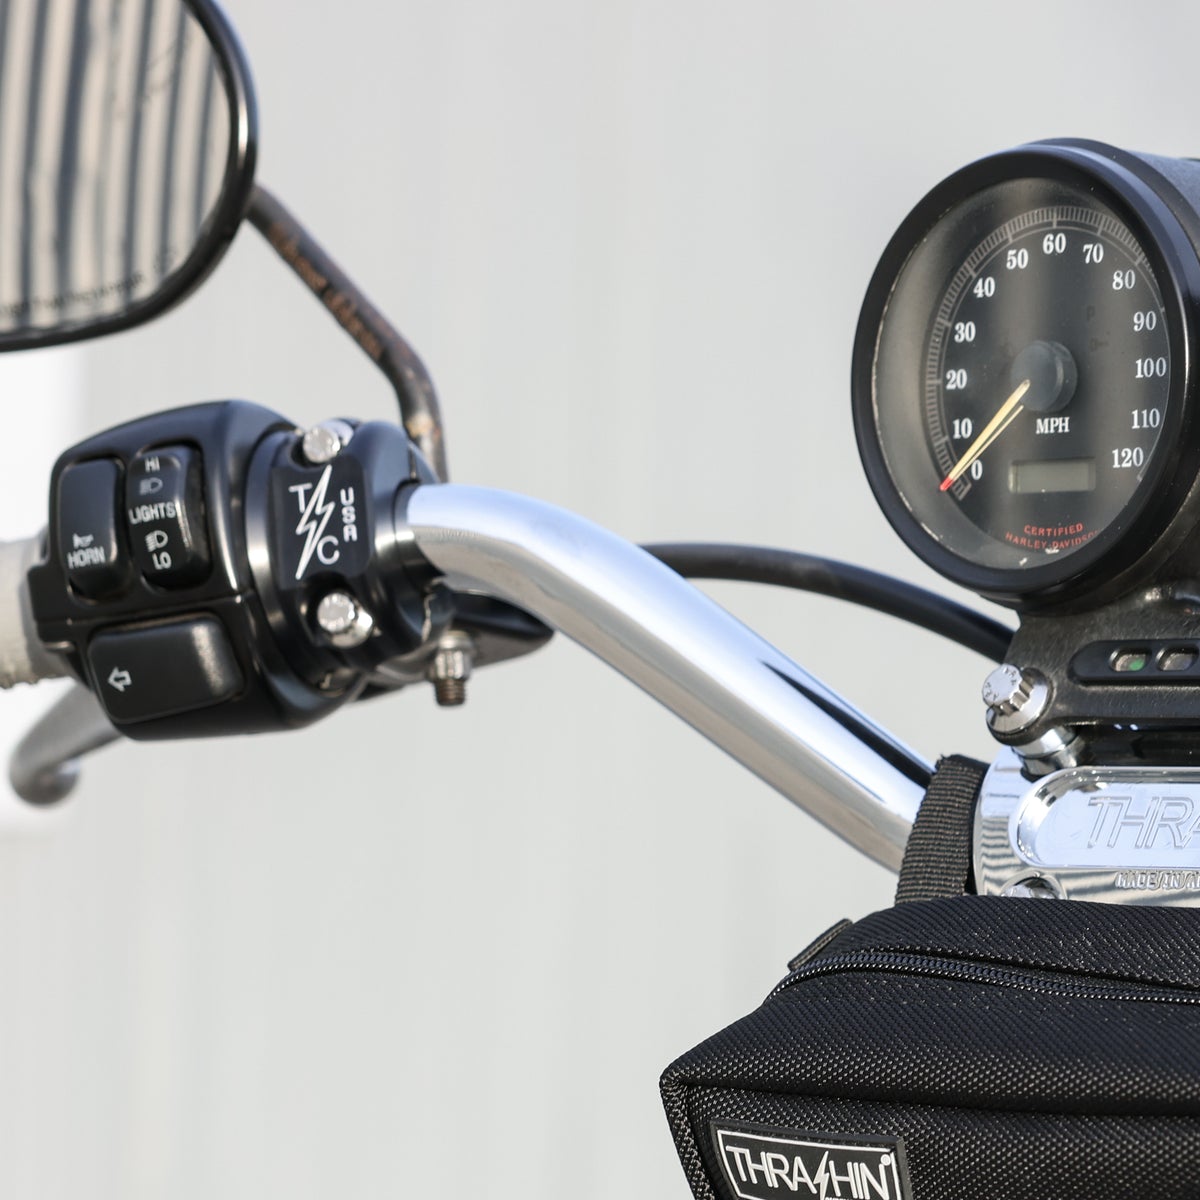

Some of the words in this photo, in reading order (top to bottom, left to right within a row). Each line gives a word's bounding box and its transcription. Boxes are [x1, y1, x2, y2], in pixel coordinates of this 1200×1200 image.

[1042, 233, 1067, 254] 60
[1082, 243, 1104, 264] 70
[1006, 249, 1029, 269] 50
[973, 277, 996, 298] 40
[1112, 270, 1136, 290] 80
[954, 321, 976, 343] 30
[1133, 311, 1157, 332] 90
[1135, 357, 1166, 379] 100
[946, 369, 968, 390] 20
[952, 418, 973, 439] 10
[1035, 416, 1070, 435] MPH
[1131, 408, 1160, 429] 110
[145, 456, 160, 471] HI
[1111, 447, 1144, 469] 120
[971, 459, 983, 480] 0
[129, 502, 177, 525] LIGHTS
[340, 488, 358, 541] USA
[1024, 522, 1084, 537] CERTIFIED
[67, 545, 105, 570] HORN
[152, 553, 172, 569] LO
[1115, 871, 1159, 888] MADE
[1161, 871, 1182, 889] IN
